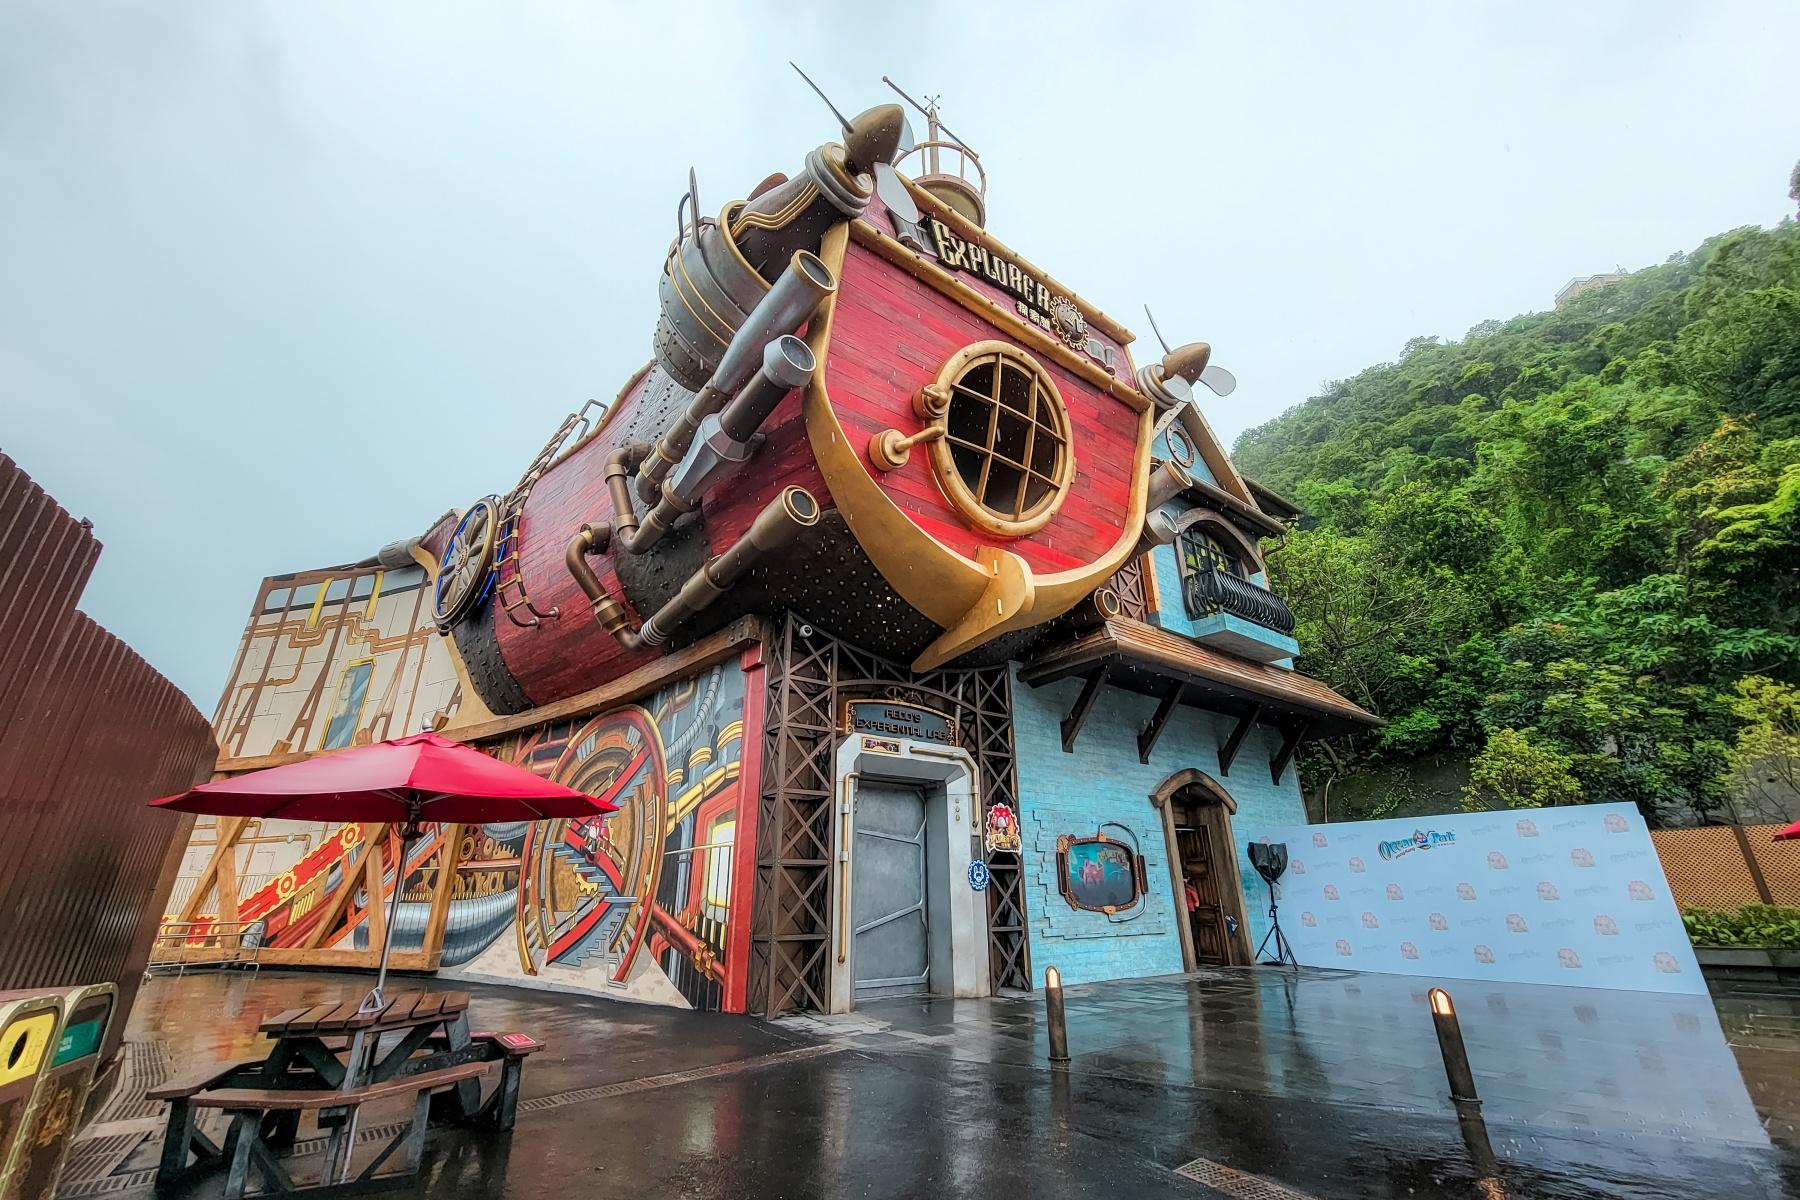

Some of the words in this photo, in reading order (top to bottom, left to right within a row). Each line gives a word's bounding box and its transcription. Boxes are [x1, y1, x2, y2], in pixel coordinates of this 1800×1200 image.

[931, 219, 1050, 312] EXPLORER
[856, 717, 924, 738] EXPERIENTIAL
[926, 729, 947, 741] LAB
